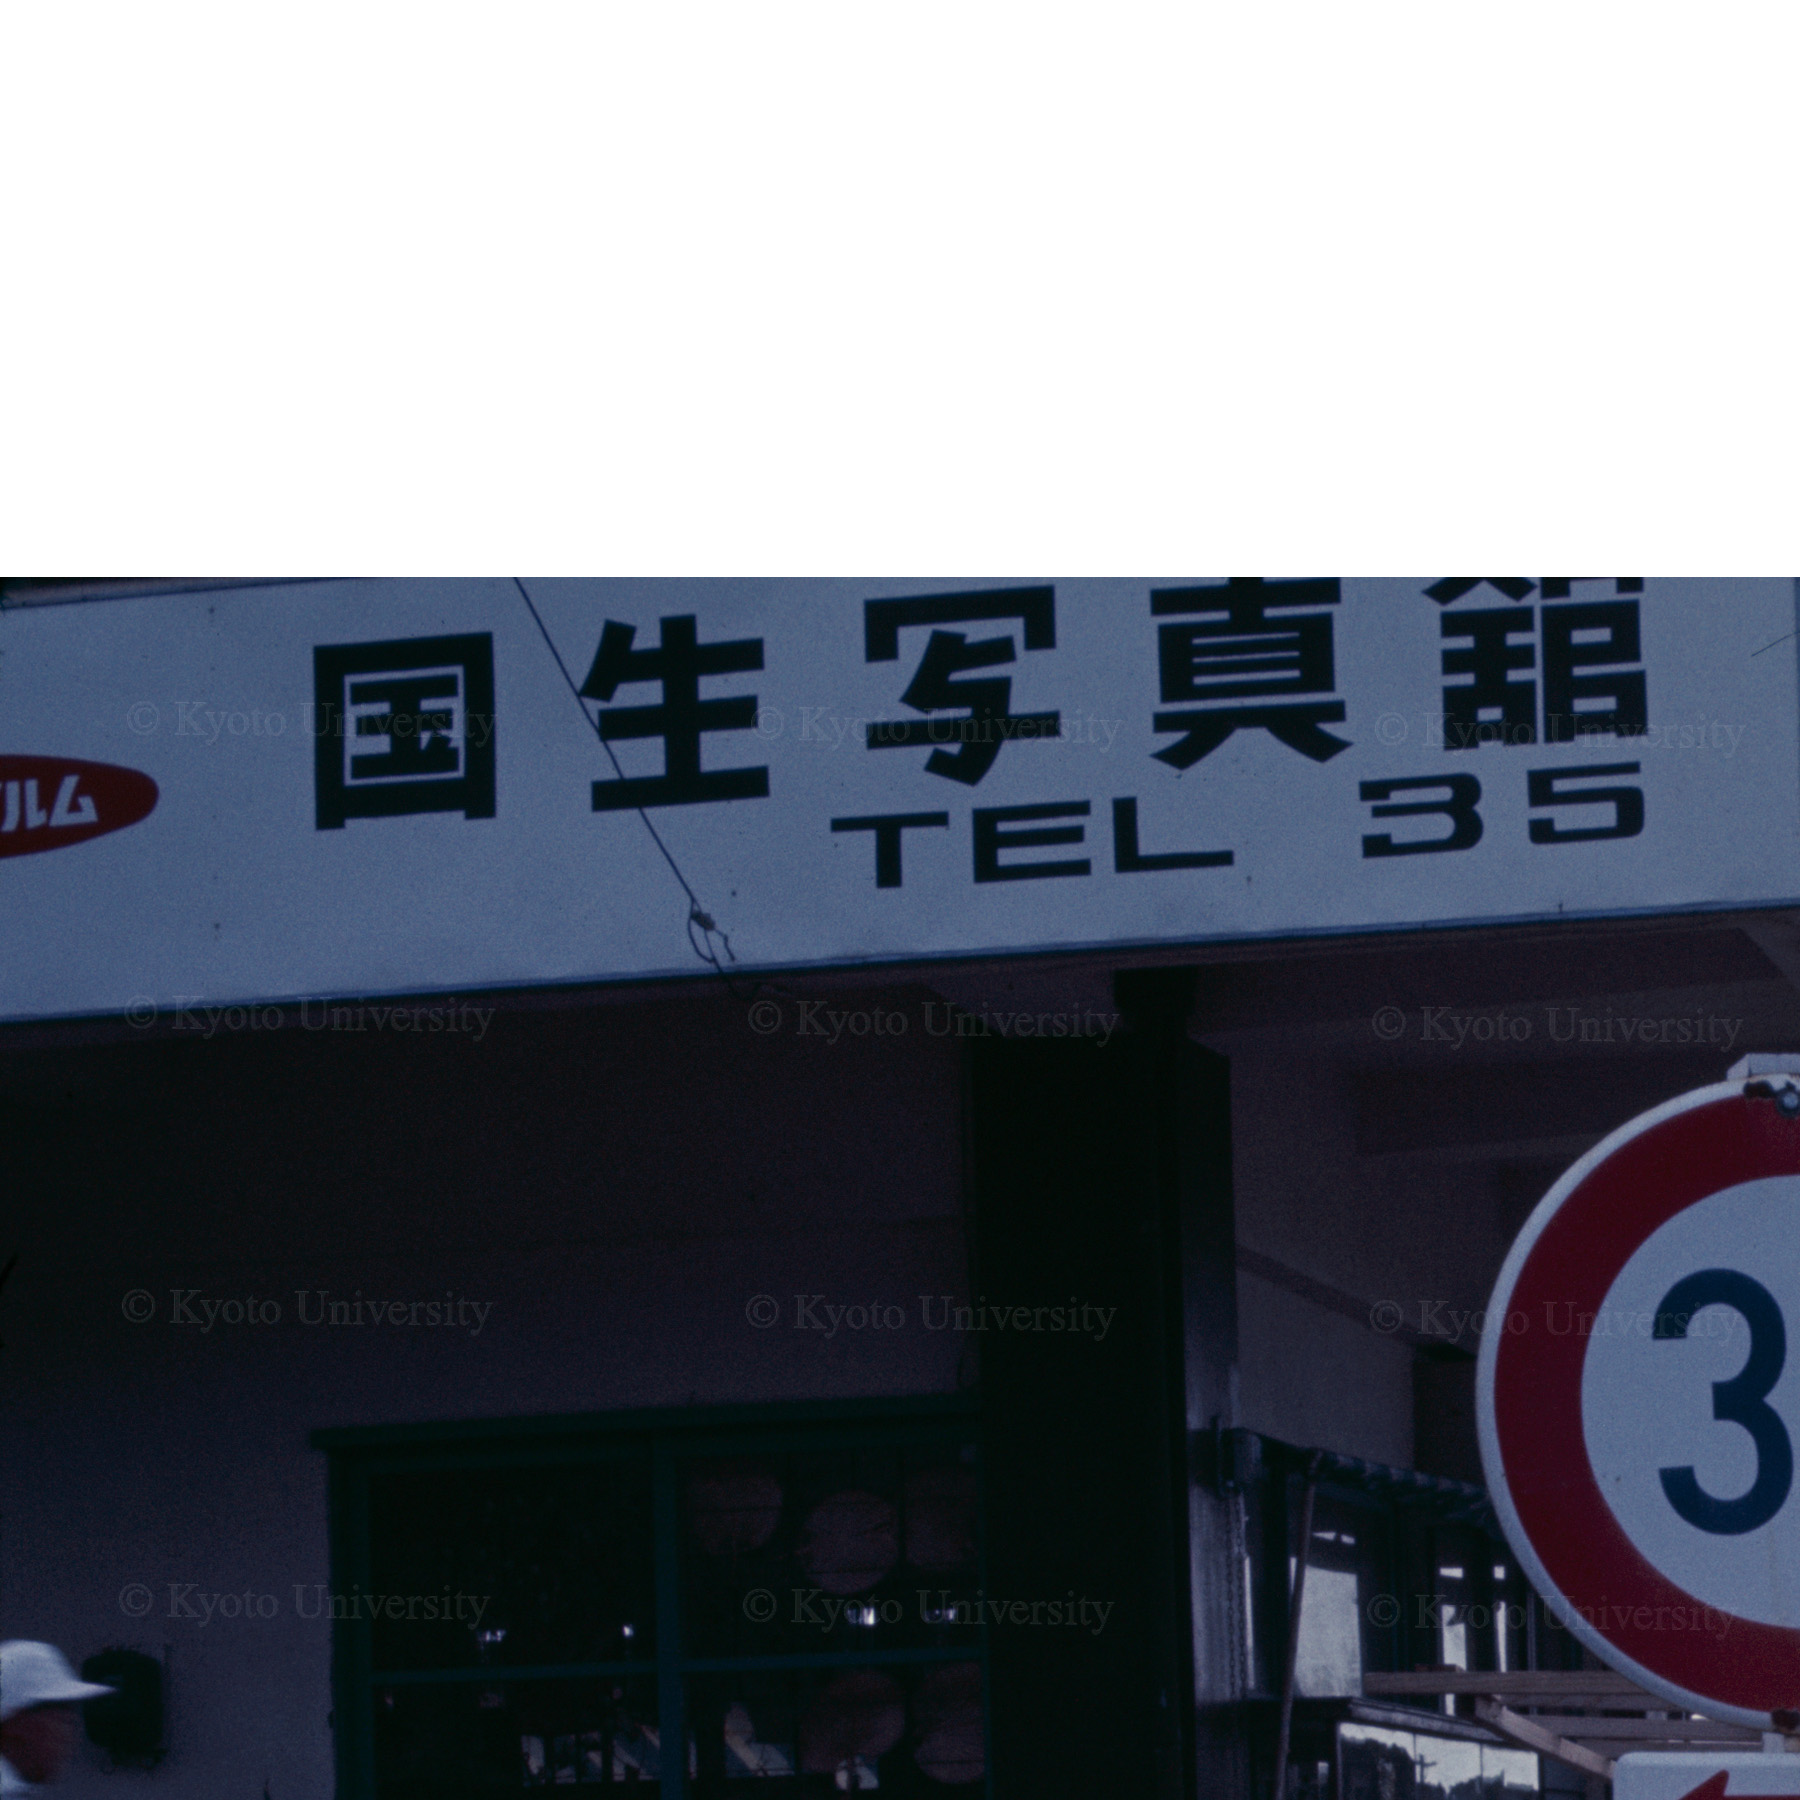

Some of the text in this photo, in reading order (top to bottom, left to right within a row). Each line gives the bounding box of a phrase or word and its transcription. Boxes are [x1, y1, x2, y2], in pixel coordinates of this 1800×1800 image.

[0, 774, 99, 833] ルム
[830, 761, 1646, 889] TEL 35
